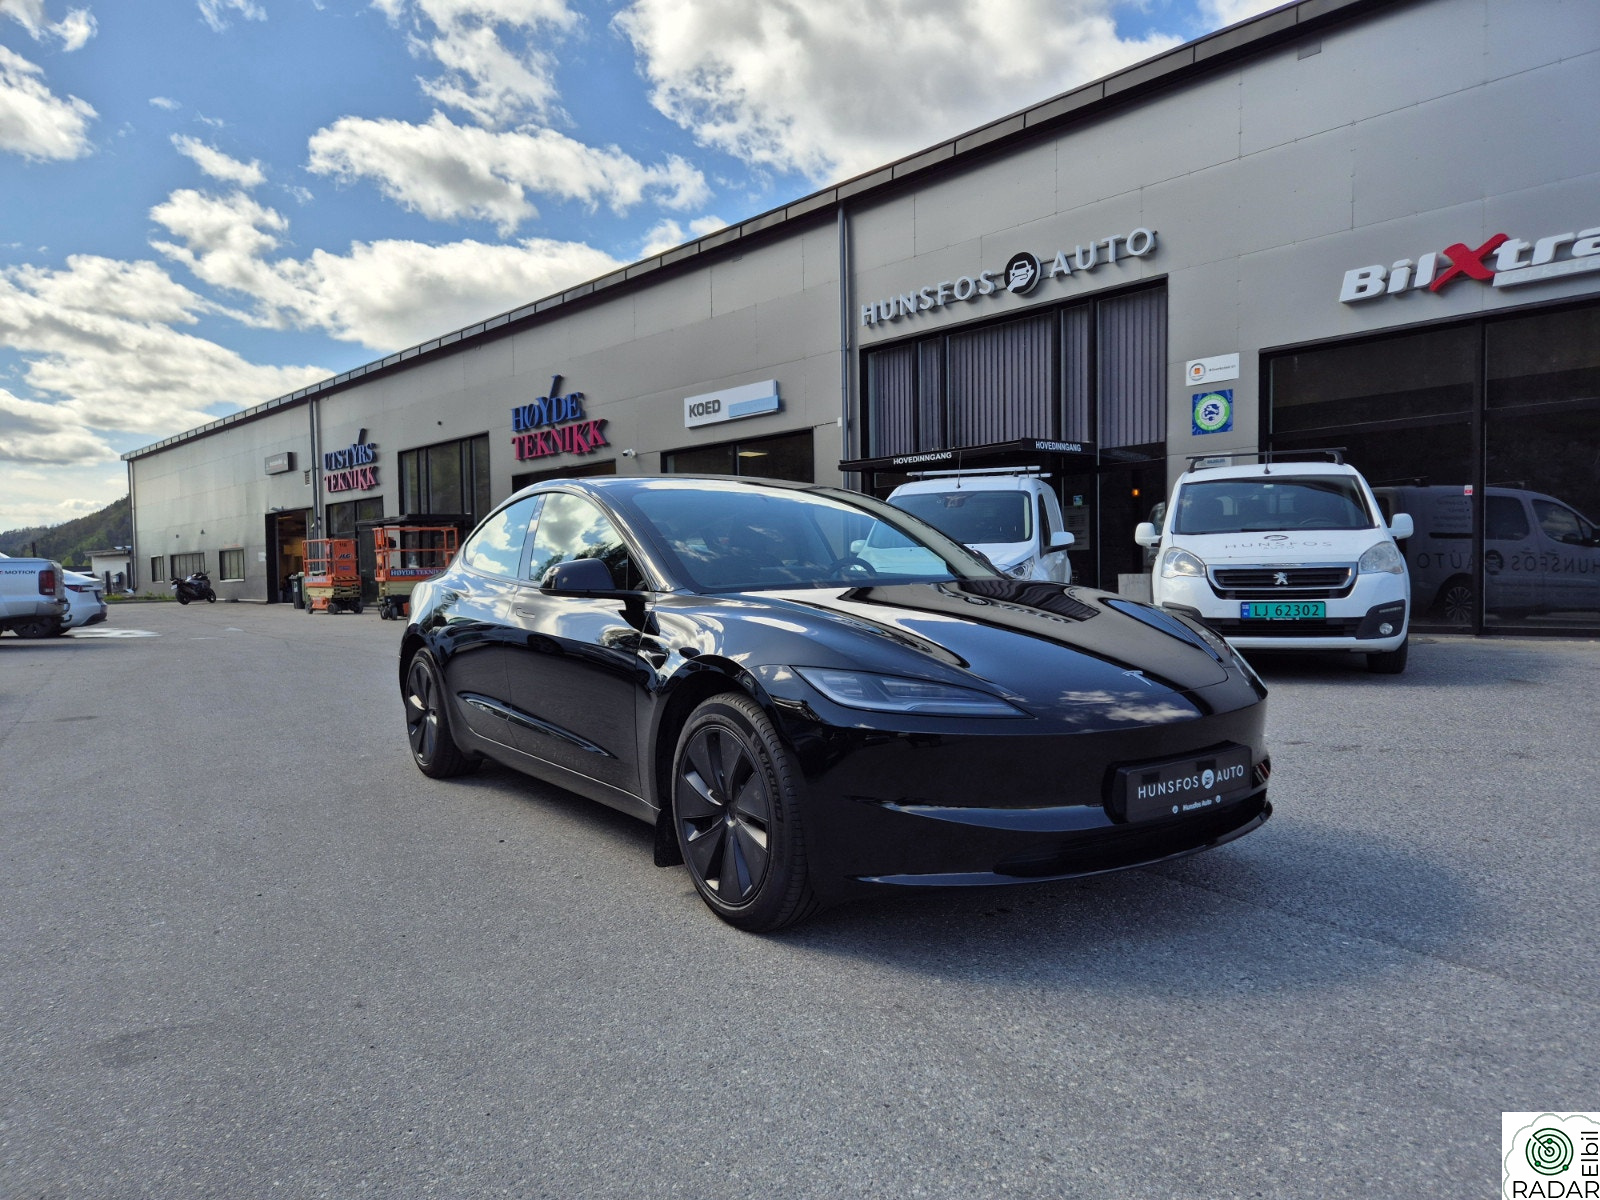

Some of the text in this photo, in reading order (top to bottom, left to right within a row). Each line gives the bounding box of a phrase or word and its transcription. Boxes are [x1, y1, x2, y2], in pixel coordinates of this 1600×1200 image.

[861, 227, 1158, 327] HUNSFOS AUTO
[511, 391, 584, 432] HØYDE
[688, 399, 721, 418] KOED
[512, 419, 608, 460] TEKNIKK
[1035, 440, 1082, 452] HOVEDINNGANG
[323, 443, 377, 471] UTSTYRS
[893, 451, 953, 466] HOVEDINNGANG
[323, 466, 378, 492] TEKNIKK
[1225, 541, 1333, 549] HUNSFOS
[1254, 604, 1319, 617] LJ 62302
[1138, 765, 1244, 798] HUNSFOS AUTO
